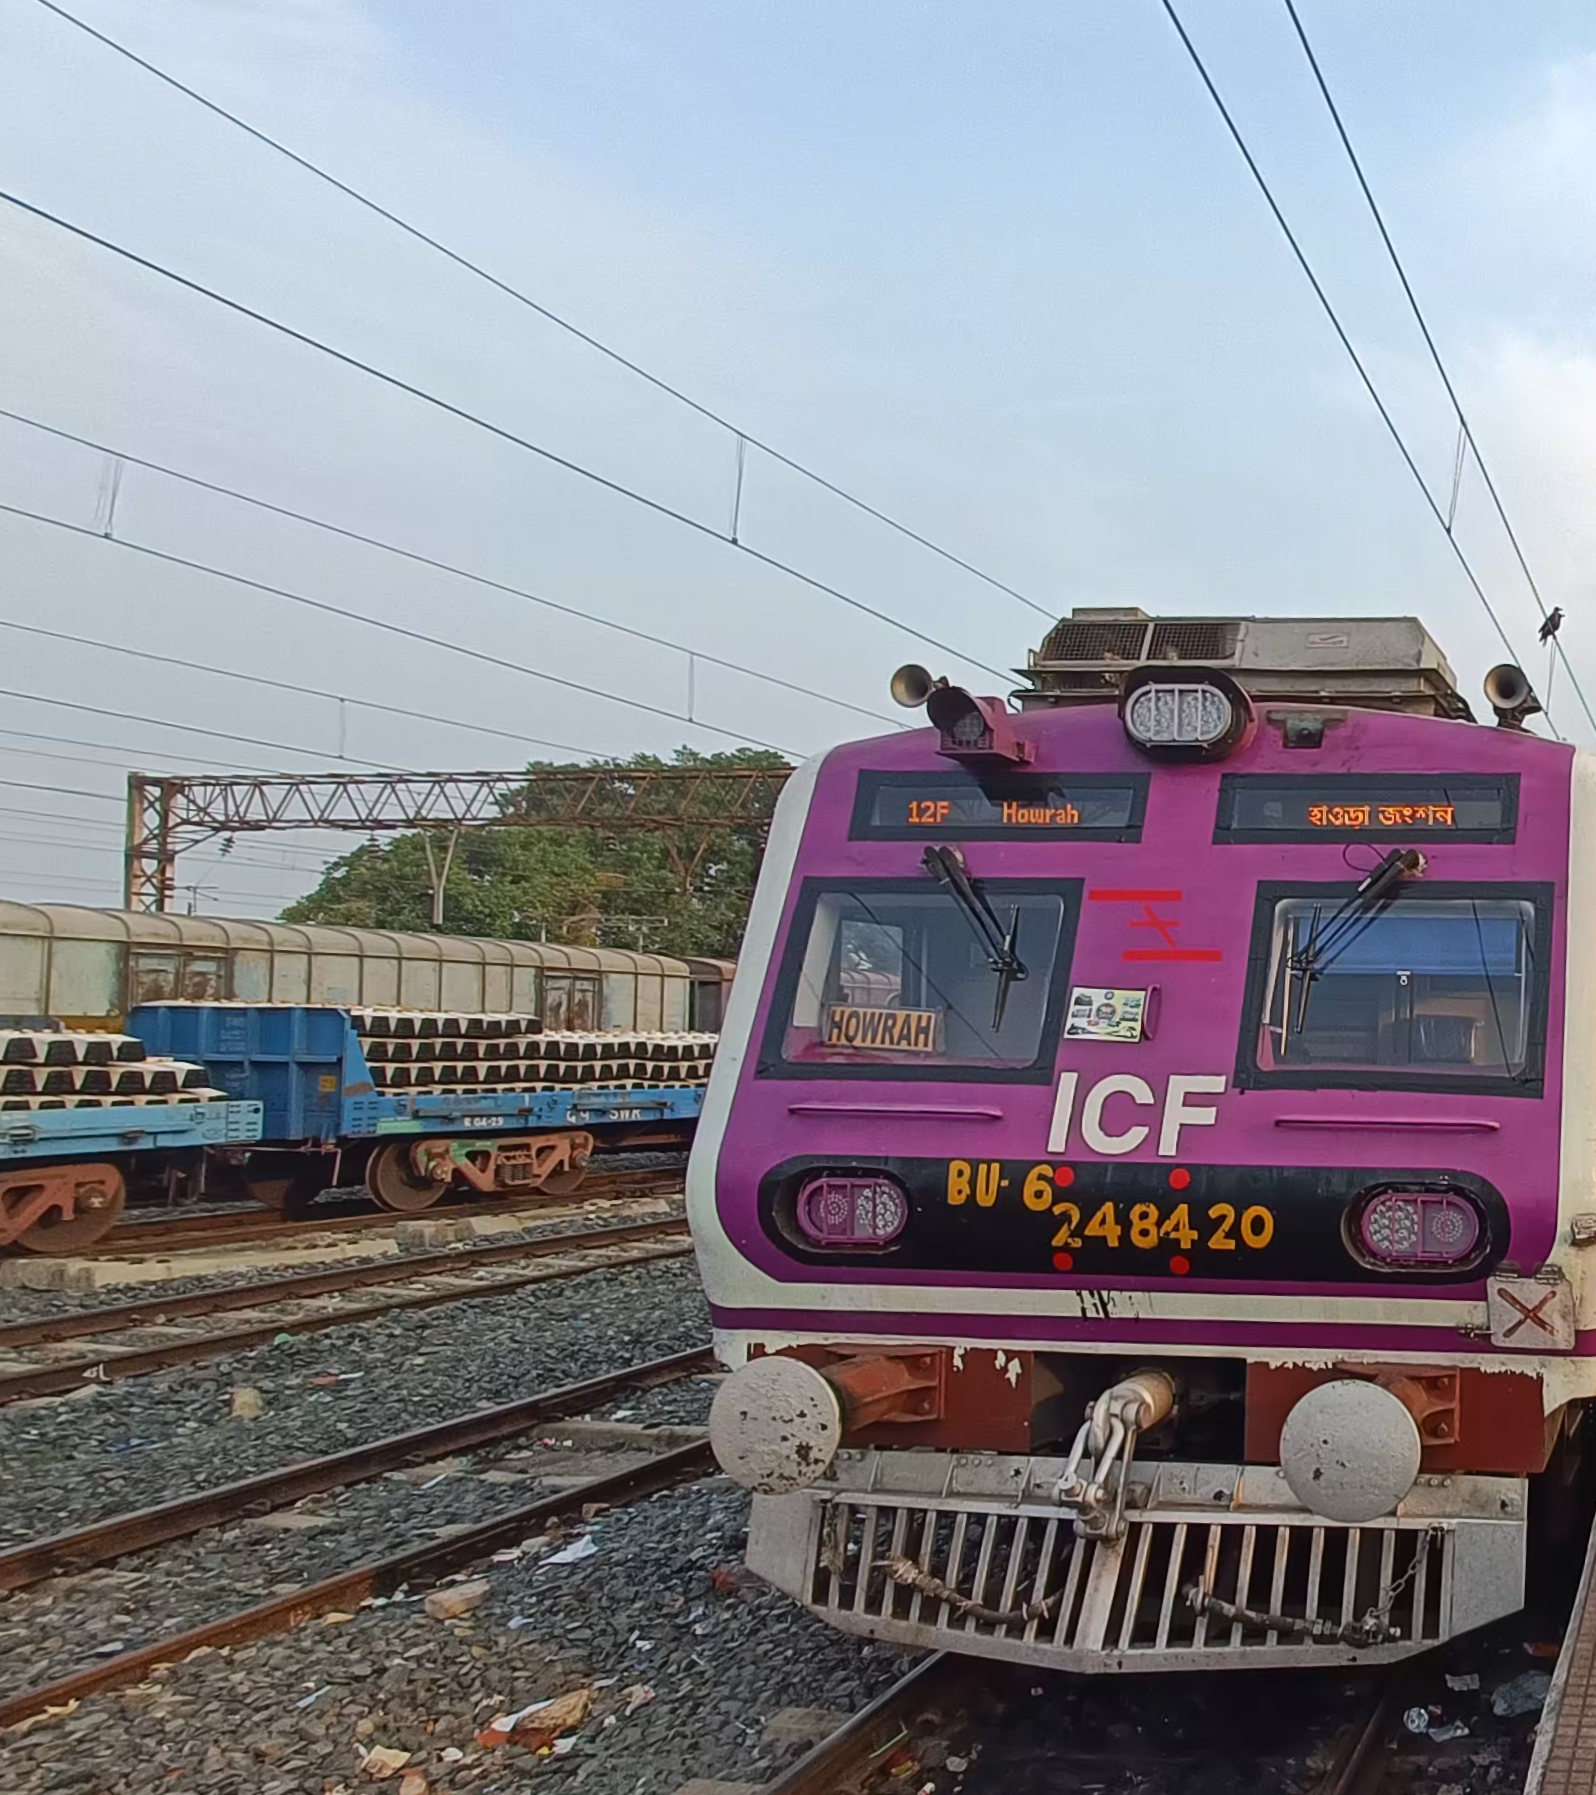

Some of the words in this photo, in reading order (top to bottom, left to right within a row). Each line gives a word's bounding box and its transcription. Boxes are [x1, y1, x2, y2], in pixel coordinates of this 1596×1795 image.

[907, 801, 950, 823] 12F
[1002, 801, 1079, 824] Howrah
[1308, 804, 1371, 830] হাওড়া
[1377, 805, 1454, 826] জংশন
[828, 1009, 933, 1048] HOWRAH
[1047, 1072, 1227, 1156] ICF
